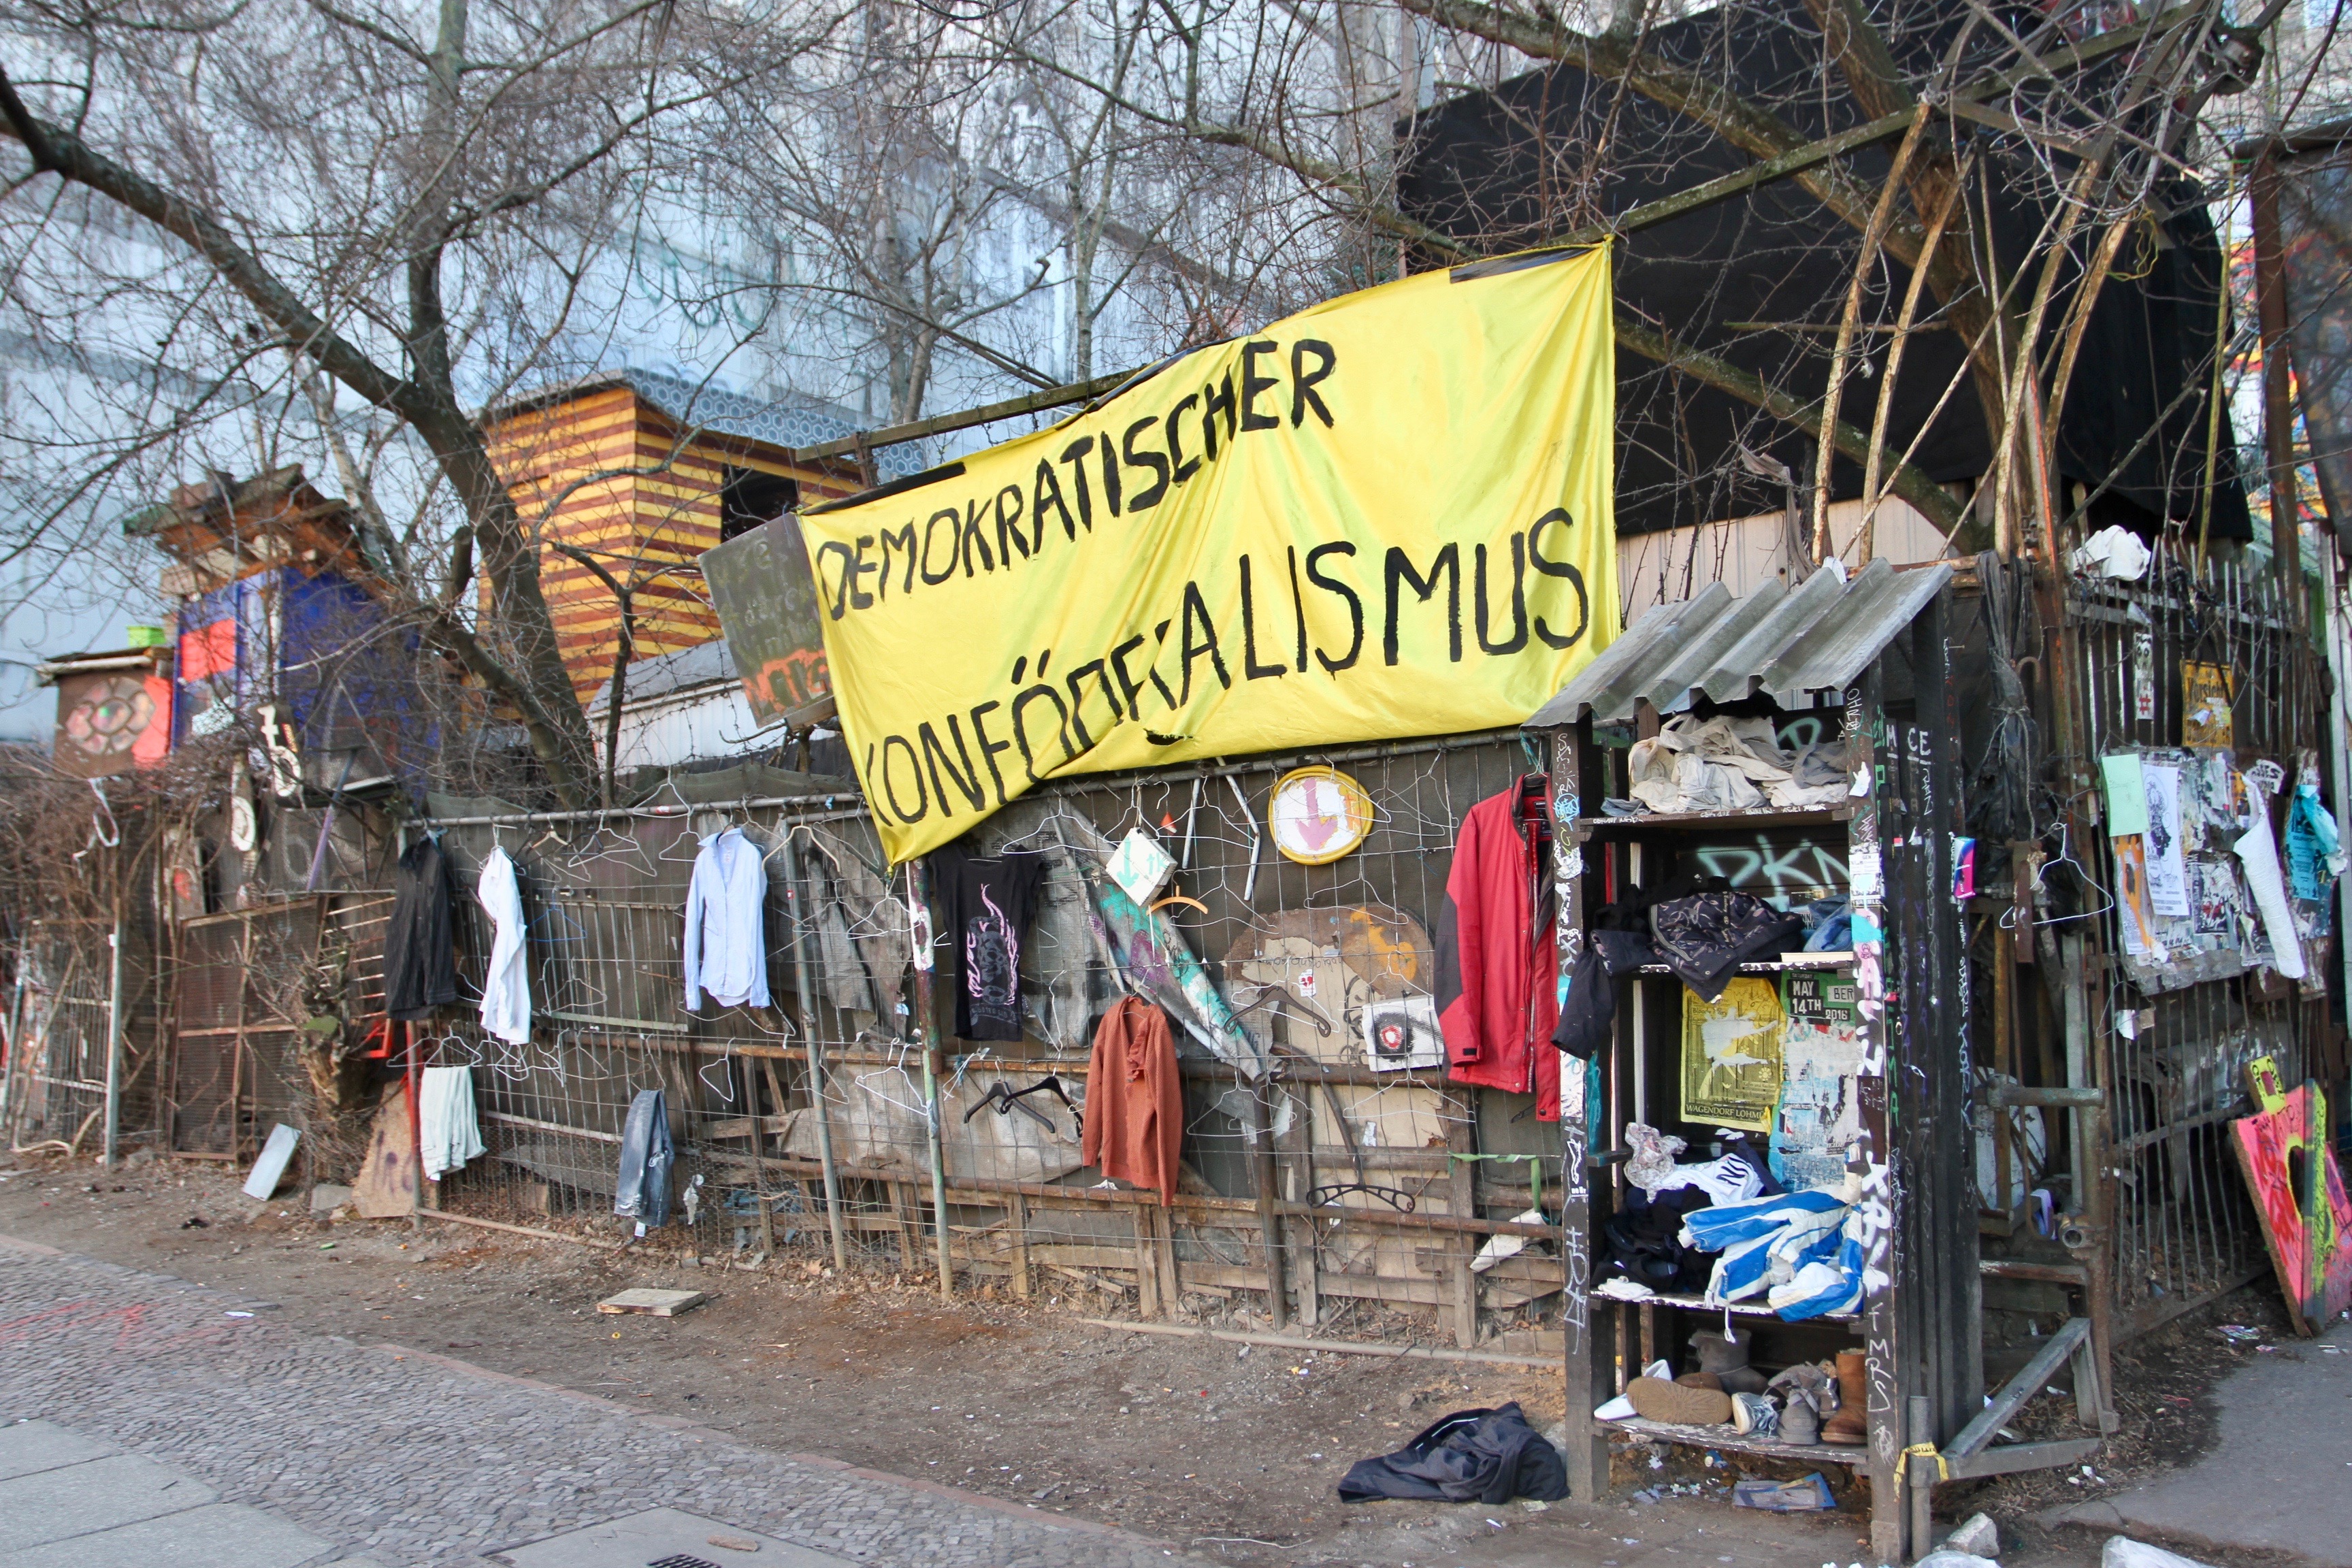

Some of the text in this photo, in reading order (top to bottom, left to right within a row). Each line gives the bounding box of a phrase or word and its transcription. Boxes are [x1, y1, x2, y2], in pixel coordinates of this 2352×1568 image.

[816, 338, 1338, 621] DEMOKRATISCHER
[1793, 981, 1814, 996] MAY
[1792, 998, 1822, 1015] 14TH
[1825, 1009, 1848, 1020] 2016
[1686, 1104, 1735, 1116] WAGENDORF
